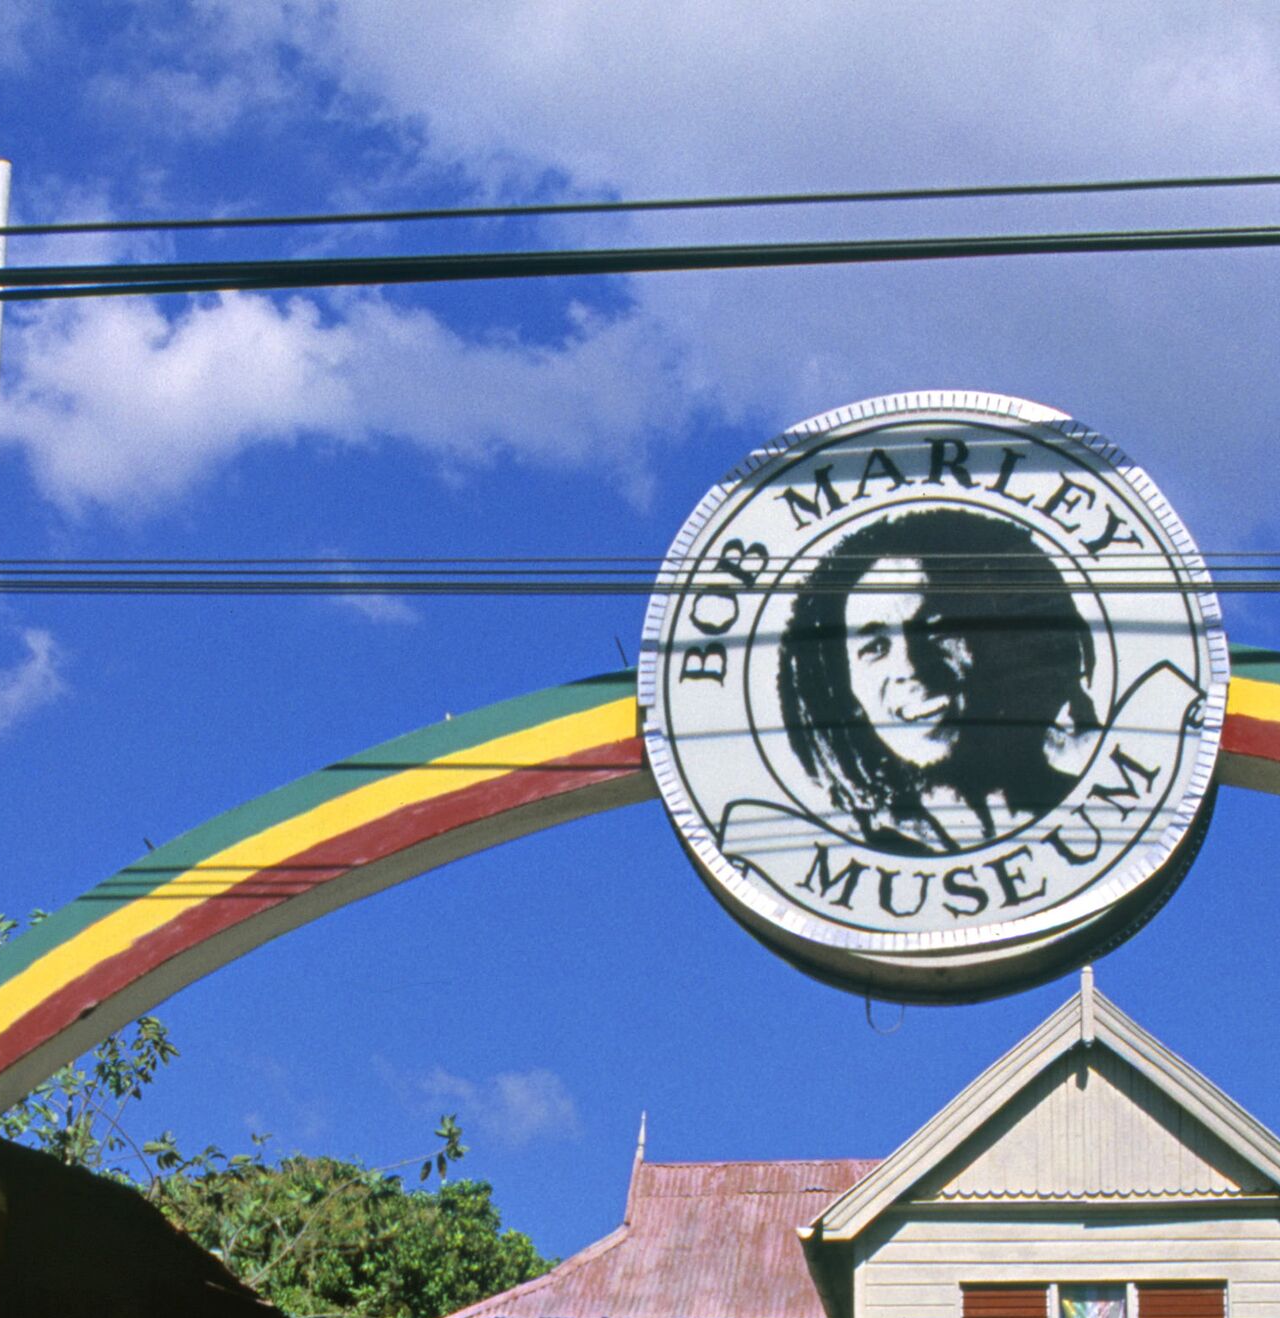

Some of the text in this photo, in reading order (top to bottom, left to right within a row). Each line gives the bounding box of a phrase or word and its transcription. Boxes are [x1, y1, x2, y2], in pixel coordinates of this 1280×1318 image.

[679, 437, 1145, 686] BOB MARLEY
[795, 745, 1162, 919] MUSEUM
